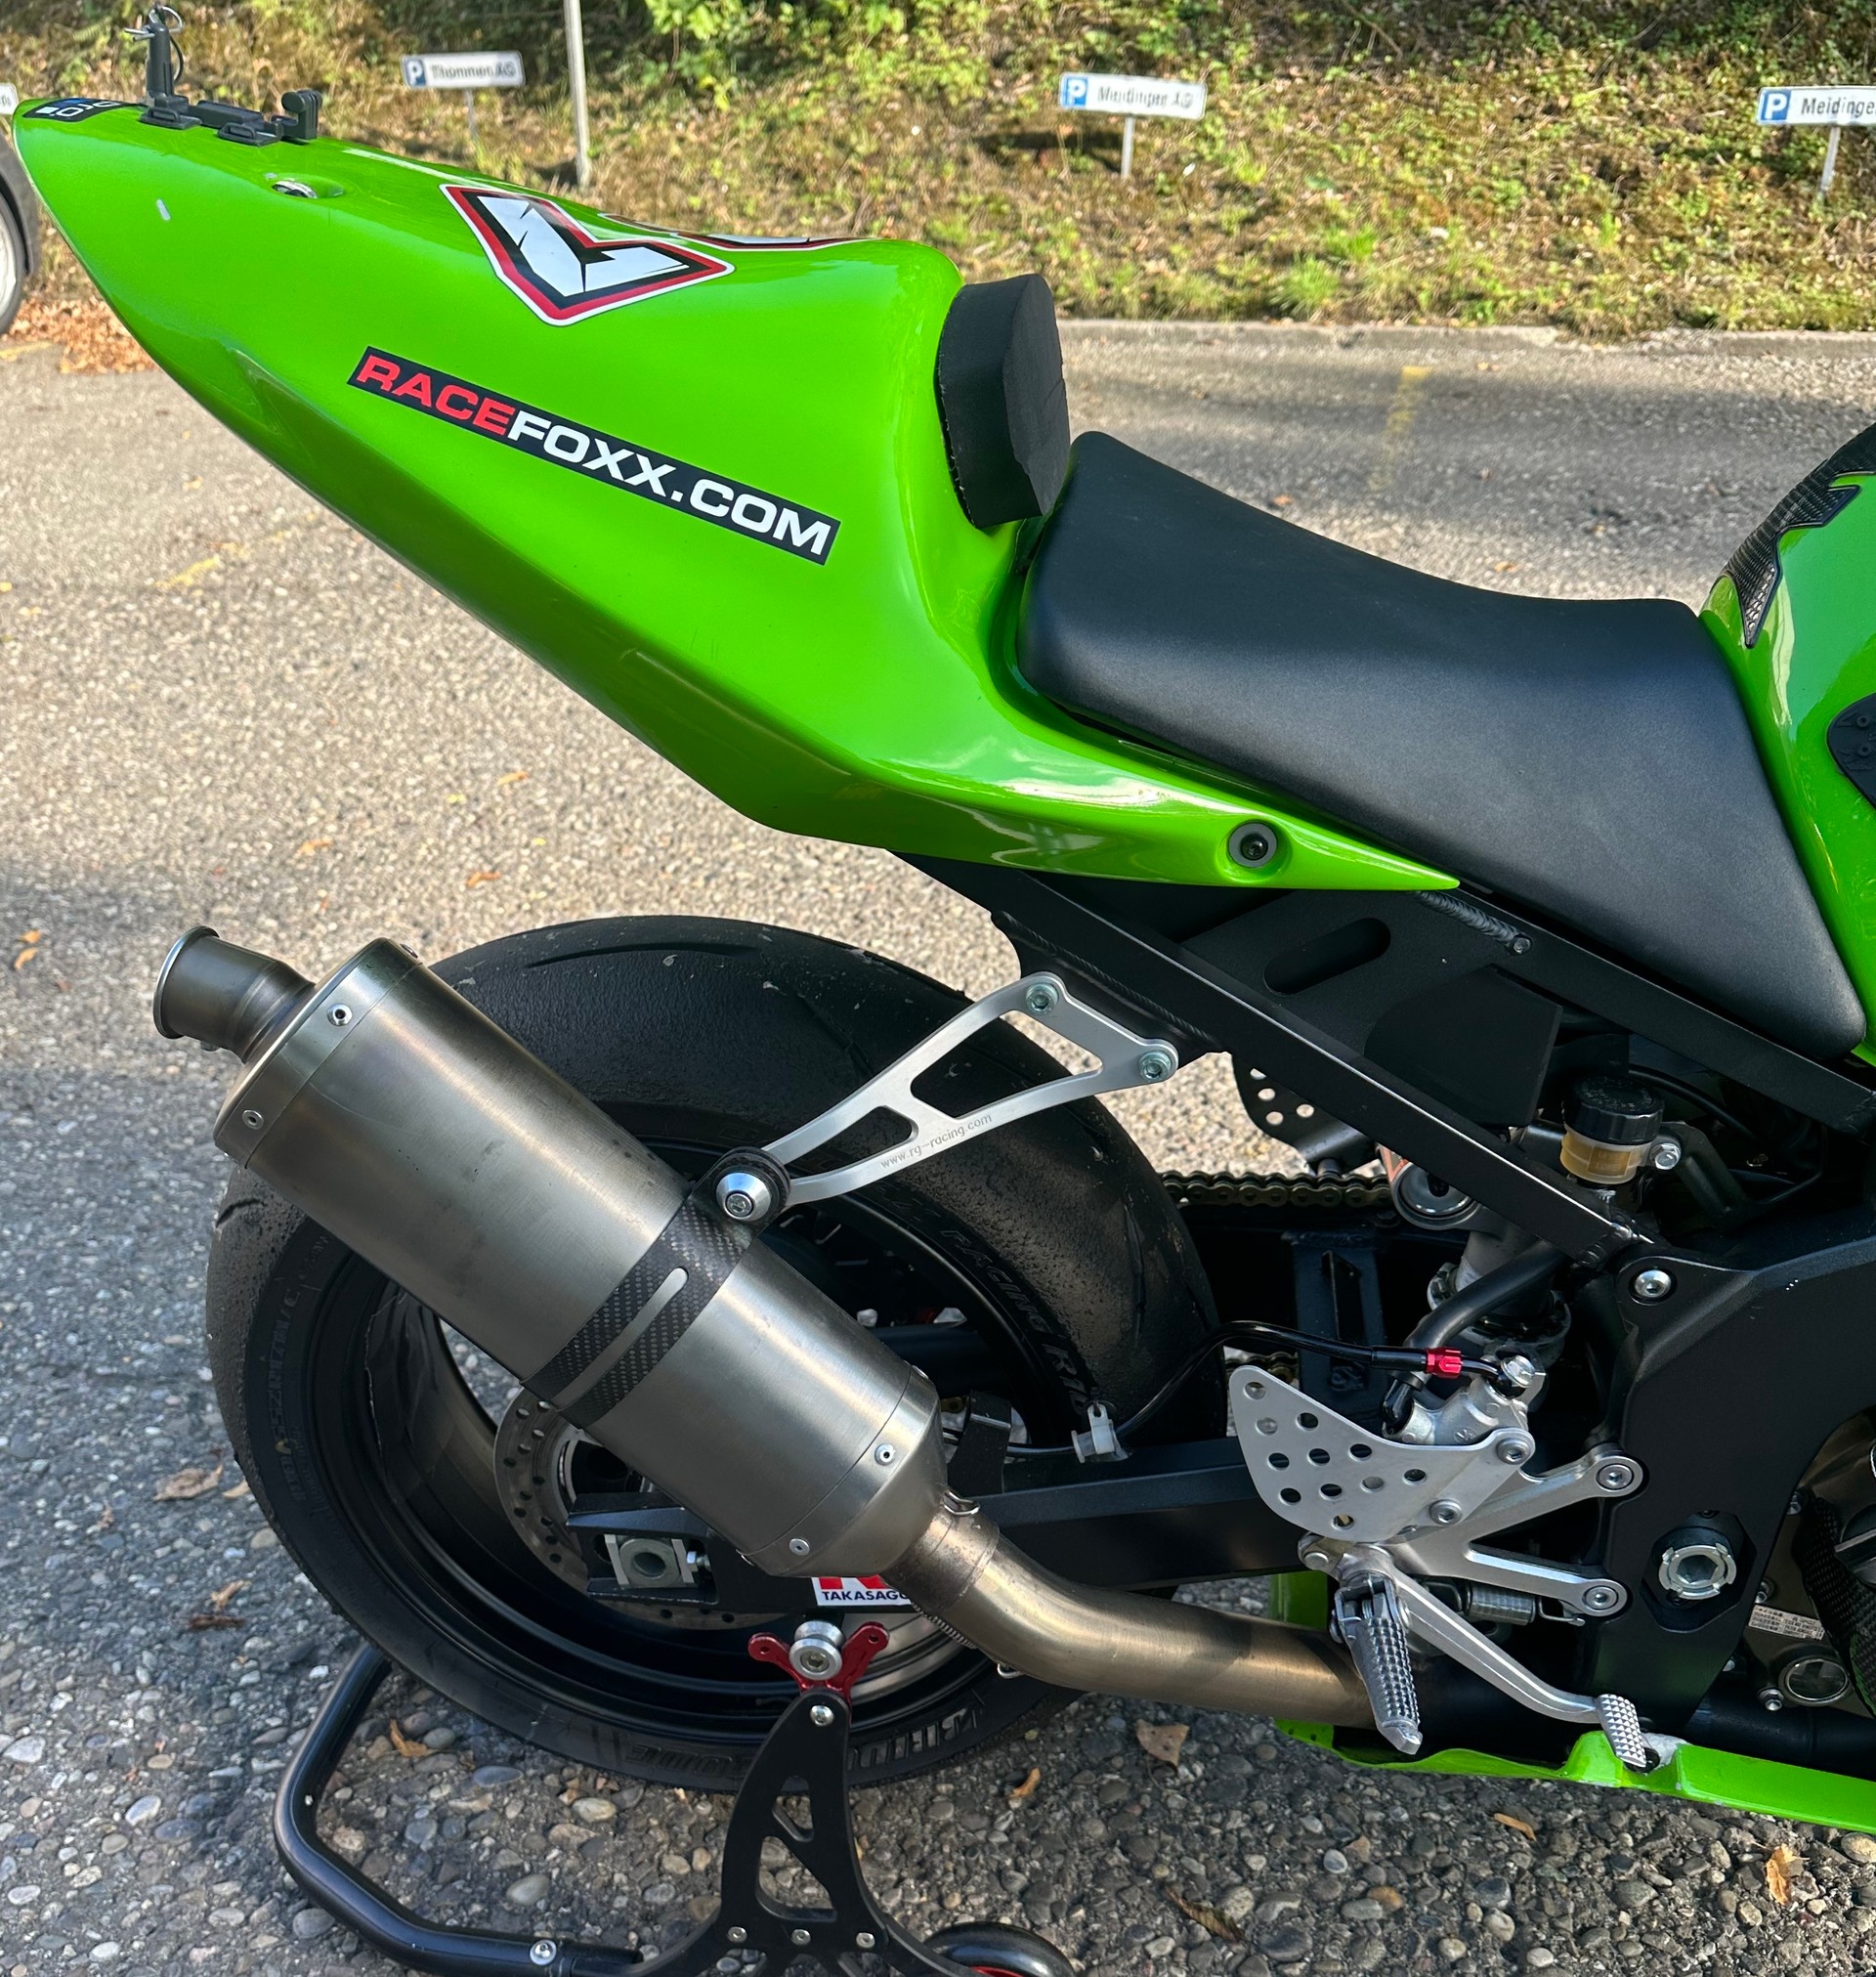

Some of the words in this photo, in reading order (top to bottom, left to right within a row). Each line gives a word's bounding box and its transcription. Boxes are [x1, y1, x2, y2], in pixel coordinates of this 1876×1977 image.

[1801, 97, 1876, 118] Meidinge
[356, 354, 832, 556] RACEFOXX.COM
[880, 1113, 993, 1169] www.rg-racing.com
